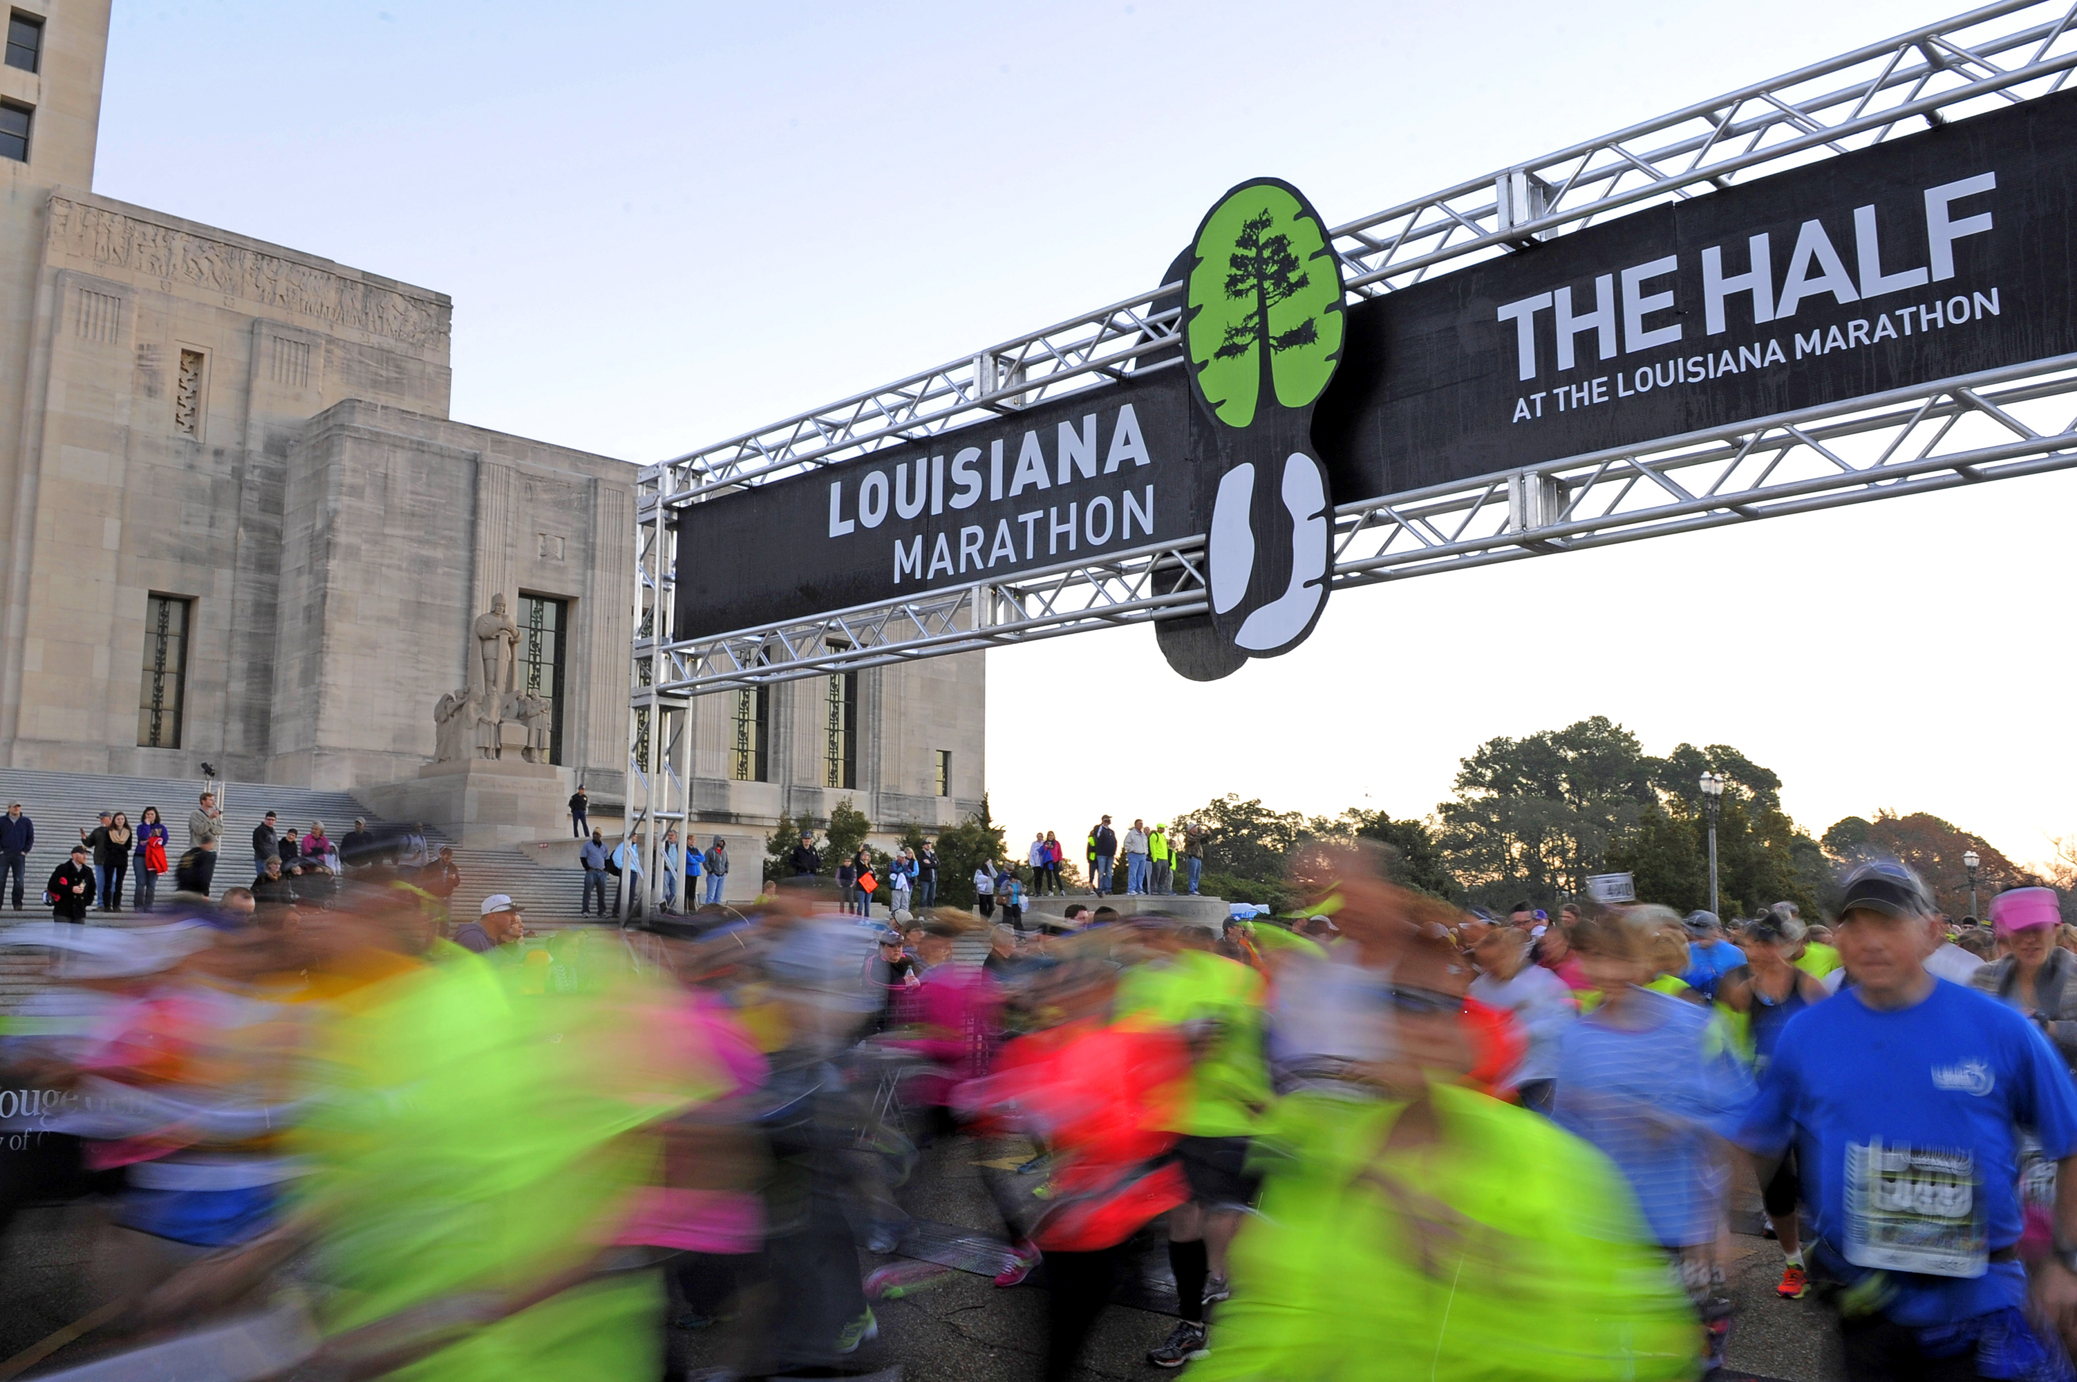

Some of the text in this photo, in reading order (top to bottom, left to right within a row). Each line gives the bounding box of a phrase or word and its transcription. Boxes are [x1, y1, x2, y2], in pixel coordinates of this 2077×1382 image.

[1497, 171, 1996, 381] THE HALF
[1513, 287, 2000, 423] AT THE LOUISIANA MARATHON
[829, 403, 1150, 538] LOUISIANA
[894, 484, 1154, 584] MARATHON
[0, 1088, 79, 1128] ouge
[9, 1128, 32, 1150] of
